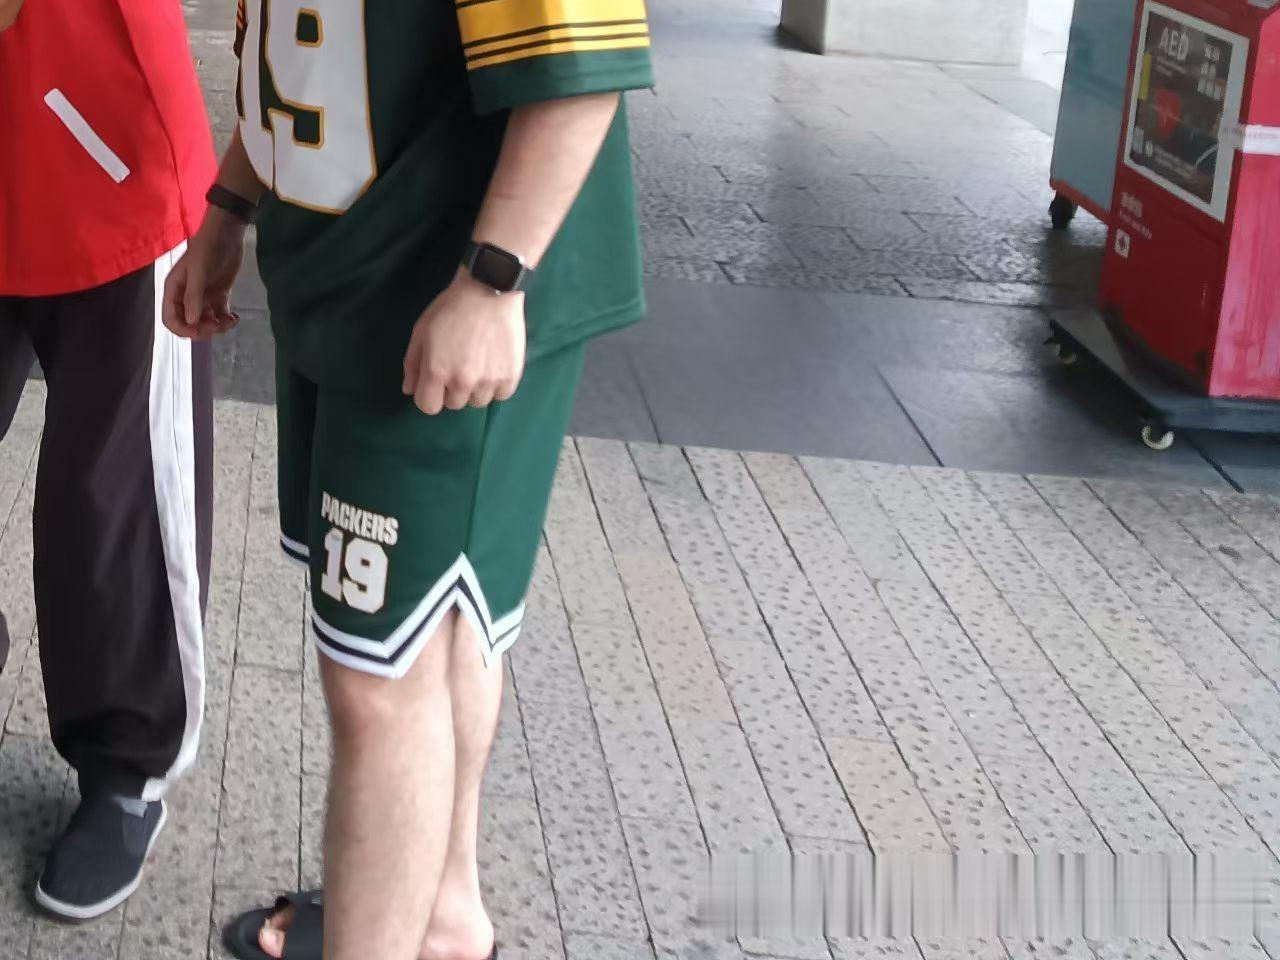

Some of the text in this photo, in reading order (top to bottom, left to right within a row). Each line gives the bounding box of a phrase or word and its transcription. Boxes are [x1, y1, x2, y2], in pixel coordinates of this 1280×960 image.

[1158, 25, 1190, 64] AED
[320, 491, 400, 547] PACKERS
[320, 527, 389, 615] 19
